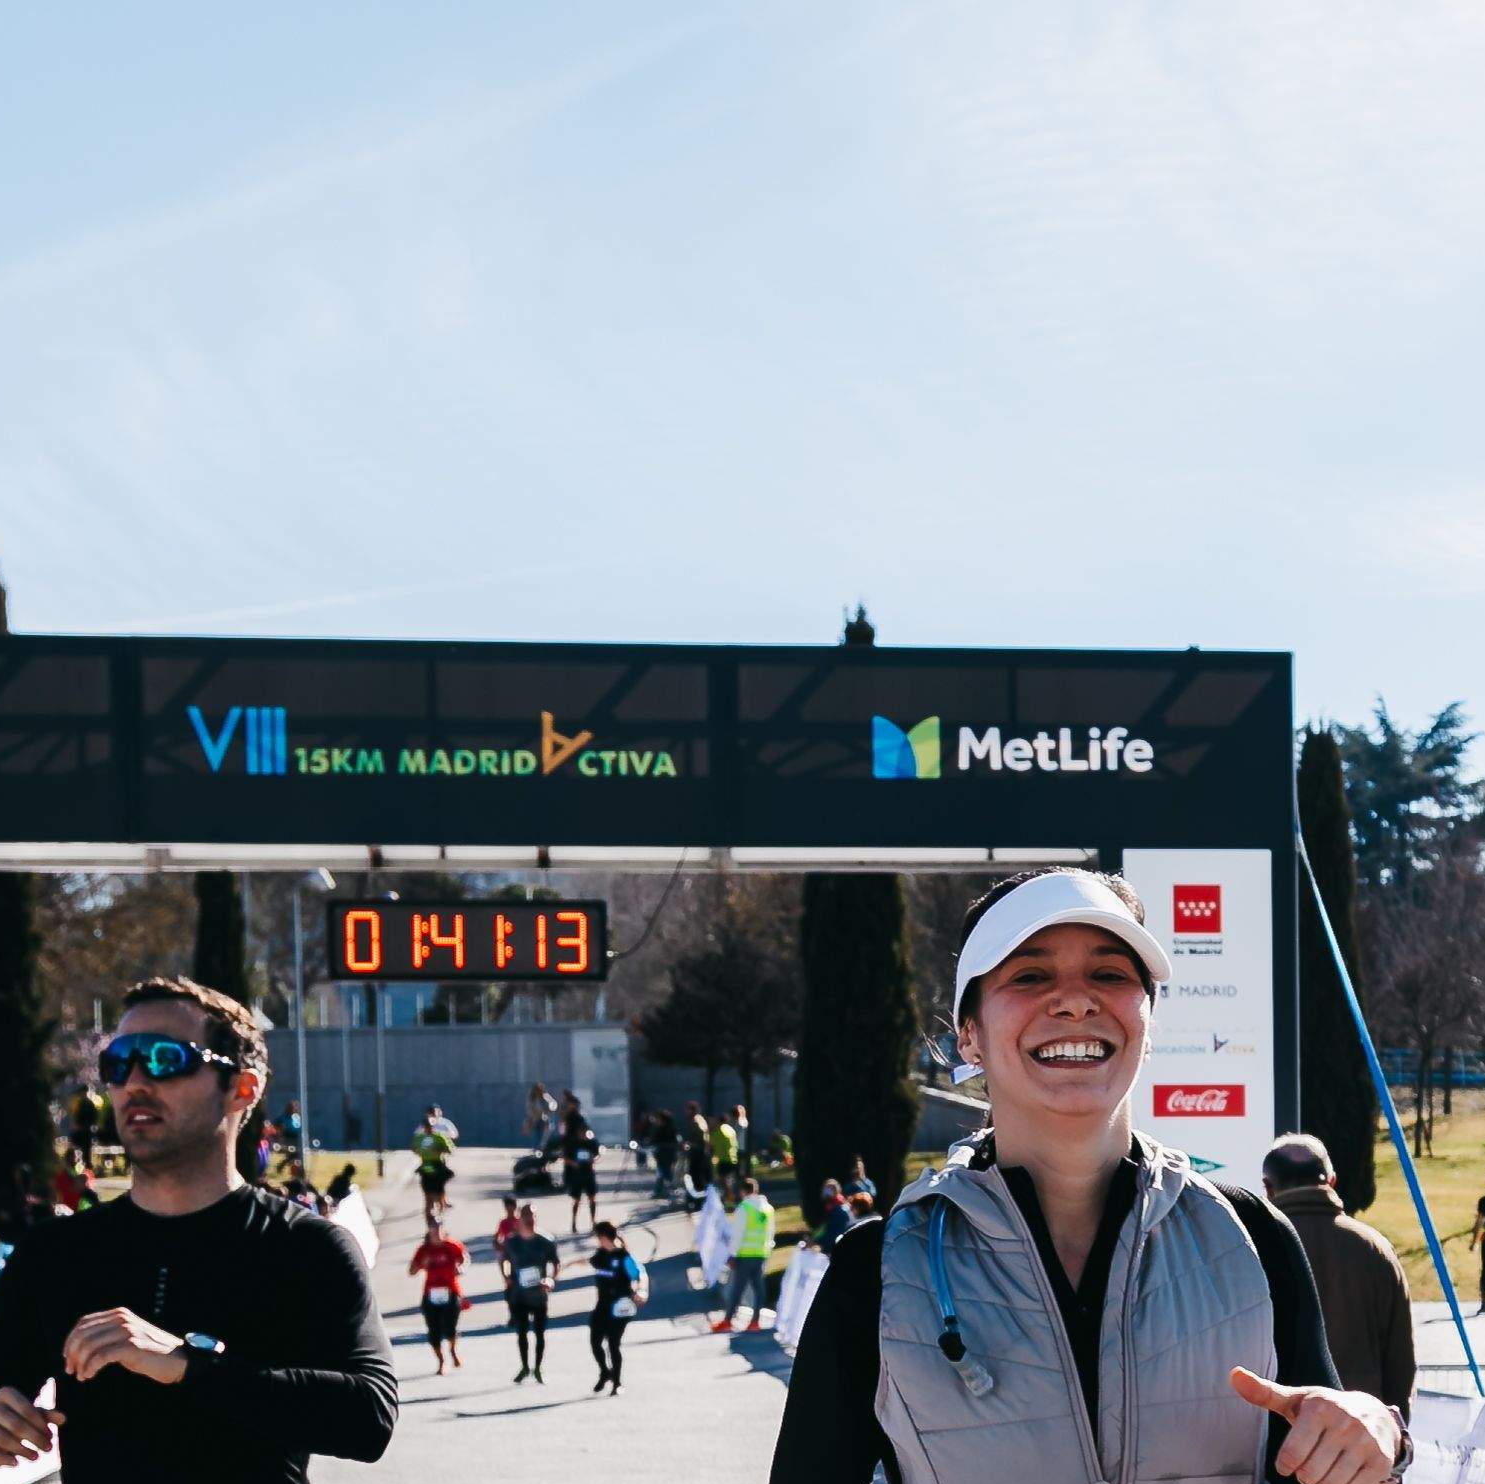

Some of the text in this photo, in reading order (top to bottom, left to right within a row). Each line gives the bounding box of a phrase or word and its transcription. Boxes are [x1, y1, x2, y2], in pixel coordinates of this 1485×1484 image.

[186, 706, 287, 776] VIII
[294, 747, 385, 775] 15KM
[398, 748, 537, 776] MADRID
[957, 726, 1155, 773] MetLife
[1179, 984, 1238, 998] MADRID
